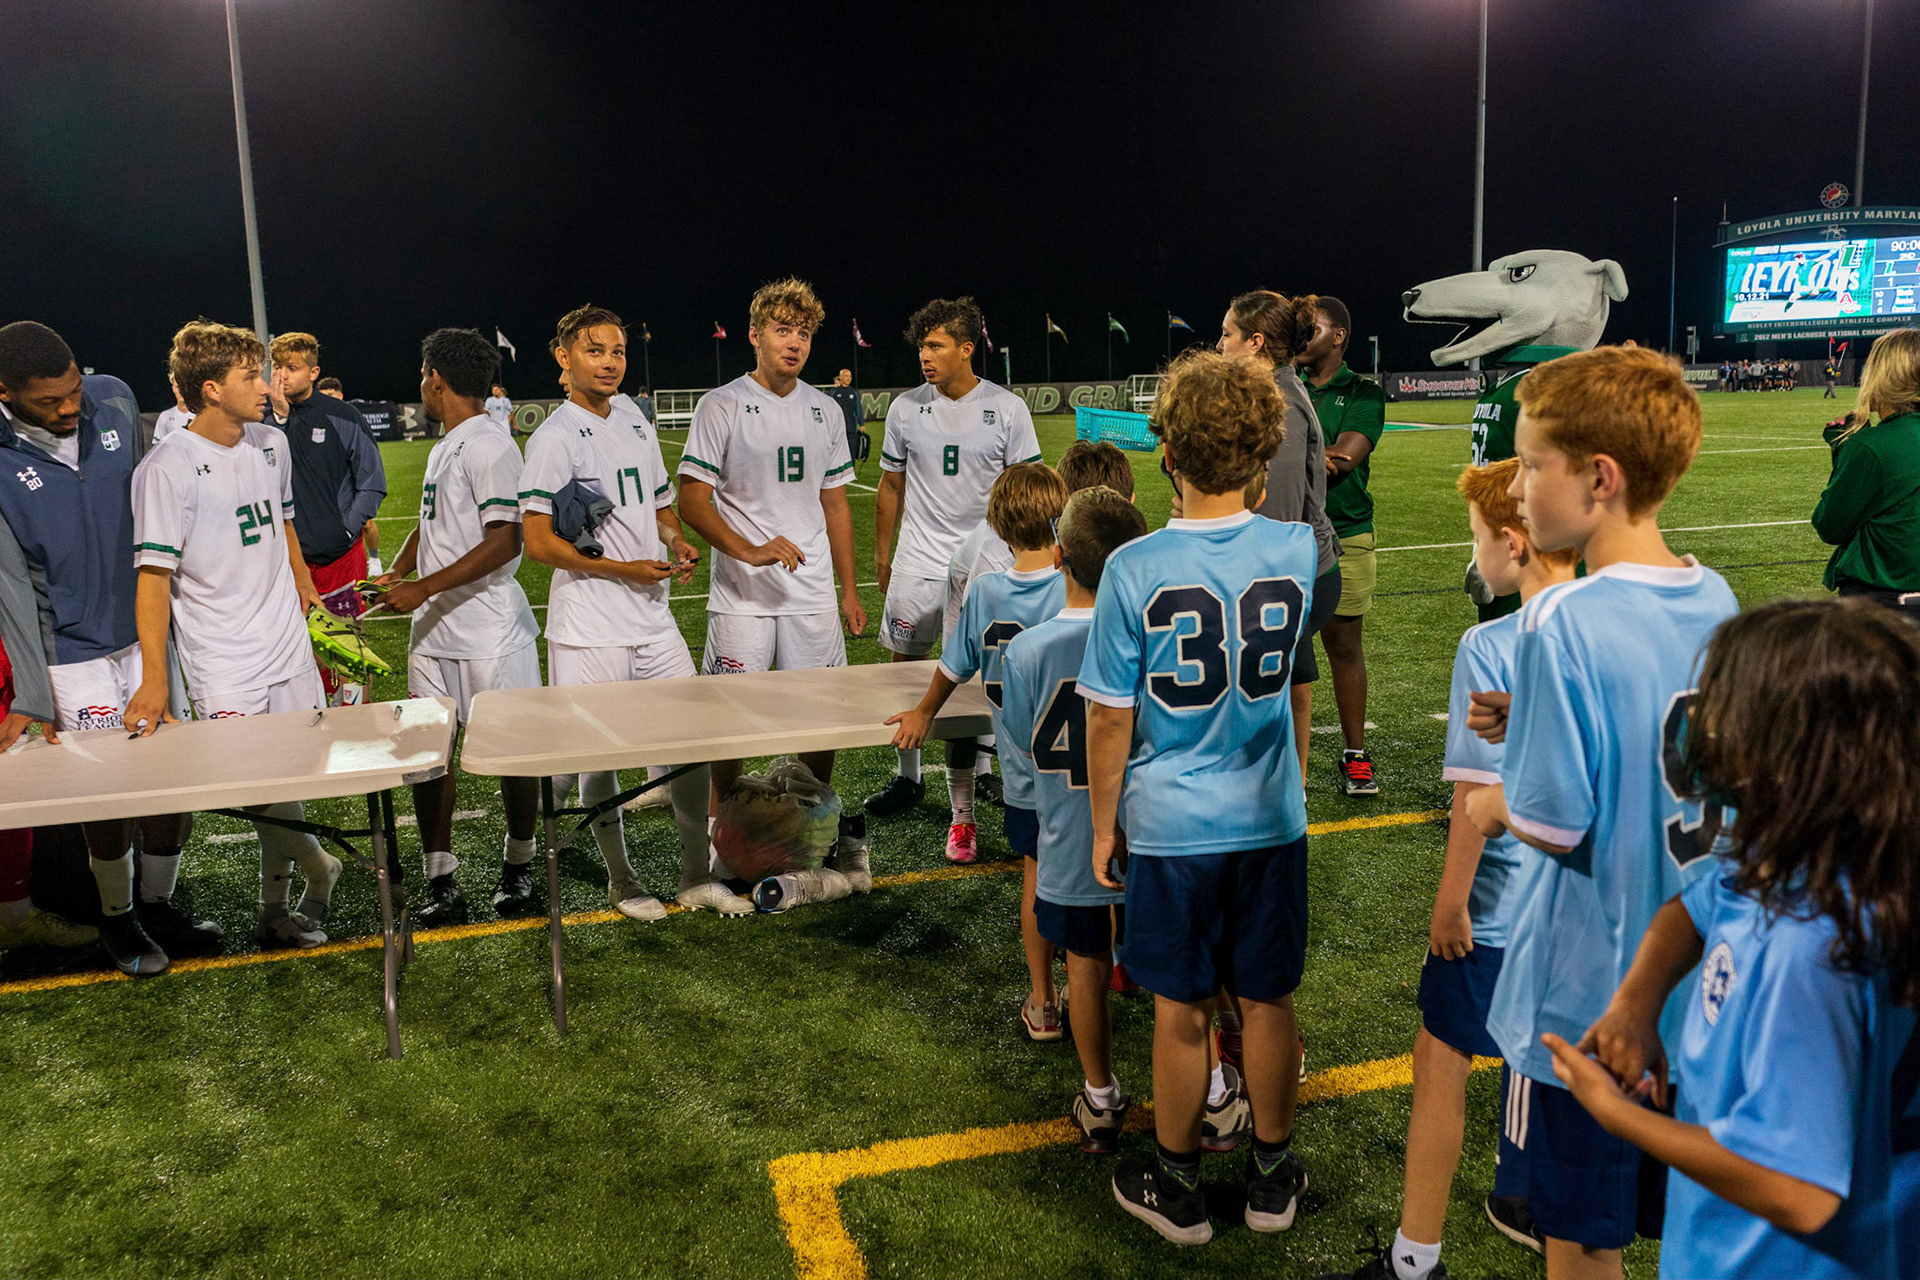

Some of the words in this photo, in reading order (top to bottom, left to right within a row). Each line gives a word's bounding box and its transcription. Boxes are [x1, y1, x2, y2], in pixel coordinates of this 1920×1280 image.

[1737, 219, 1781, 235] LOYOLA
[1785, 211, 1860, 226] UNIVERSITY
[1864, 210, 1920, 219] MARYLA
[1887, 276, 1894, 287] 1
[1734, 292, 1770, 302] 10.12.21
[1771, 332, 1792, 340] MEN'S
[1793, 331, 1826, 339] LACROSSE
[1828, 329, 1860, 337] NATIONAL
[1774, 319, 1837, 328] INTERCOLLEGIATE
[1840, 317, 1874, 325] ATHLETIC
[1877, 315, 1912, 323] COMPLEX
[1418, 379, 1465, 392] SMOOTHIE
[1464, 377, 1480, 391] KIN
[1013, 386, 1060, 413] ND
[1471, 423, 1489, 467] 52
[778, 446, 804, 482] 19
[943, 445, 959, 476] 8
[26, 476, 43, 491] 20
[617, 467, 643, 507] 17
[235, 499, 276, 547] 24
[1142, 575, 1306, 712] 38
